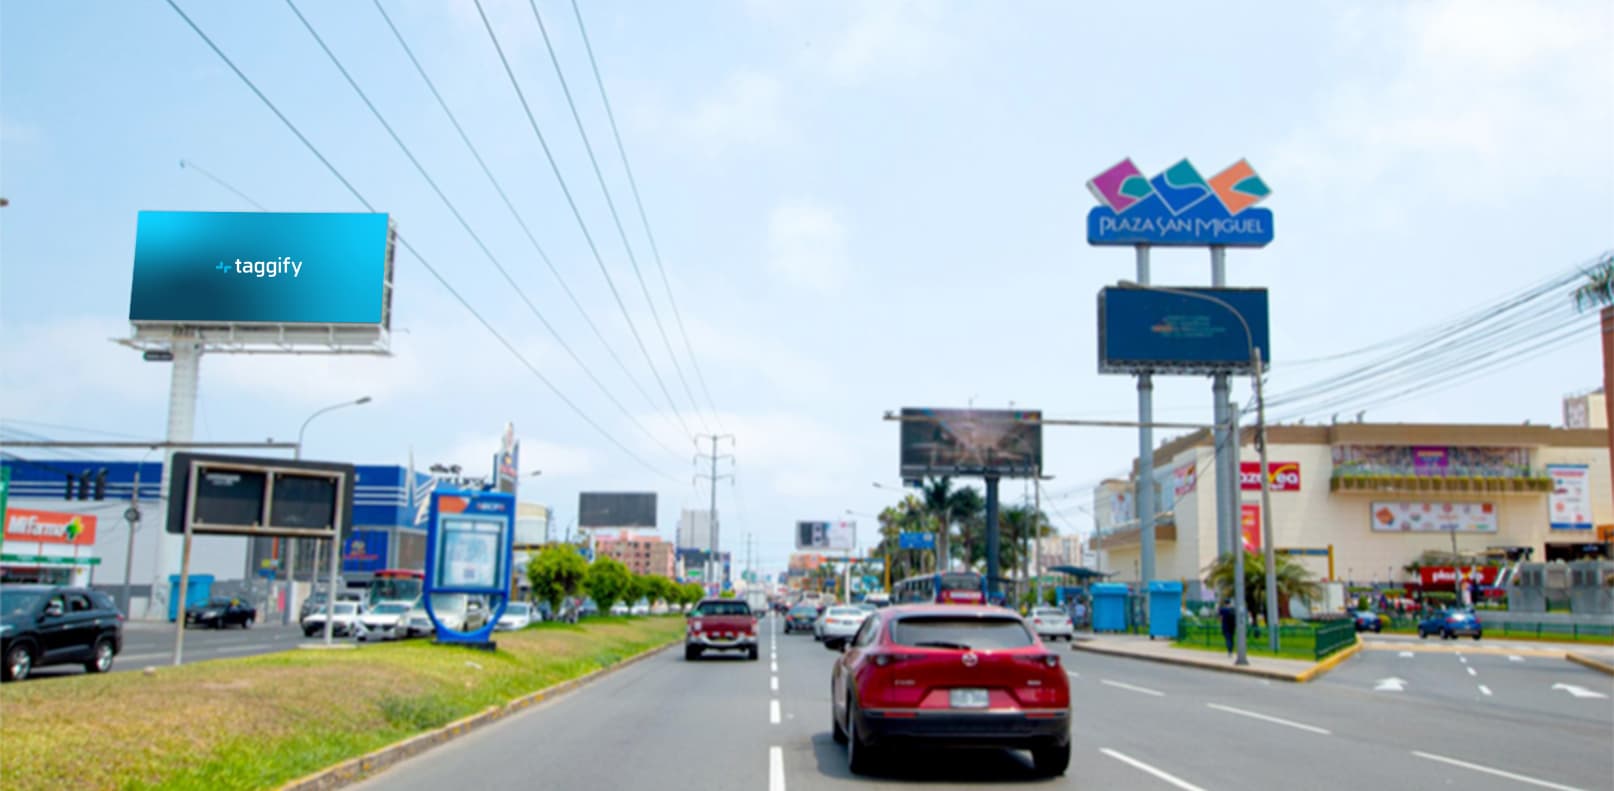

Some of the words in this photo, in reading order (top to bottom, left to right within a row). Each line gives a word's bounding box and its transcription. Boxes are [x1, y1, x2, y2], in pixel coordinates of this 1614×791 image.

[1099, 216, 1155, 237] PLAZA
[1156, 216, 1192, 237] SAN
[1195, 217, 1264, 238] MIGUEL
[235, 256, 303, 278] taggify
